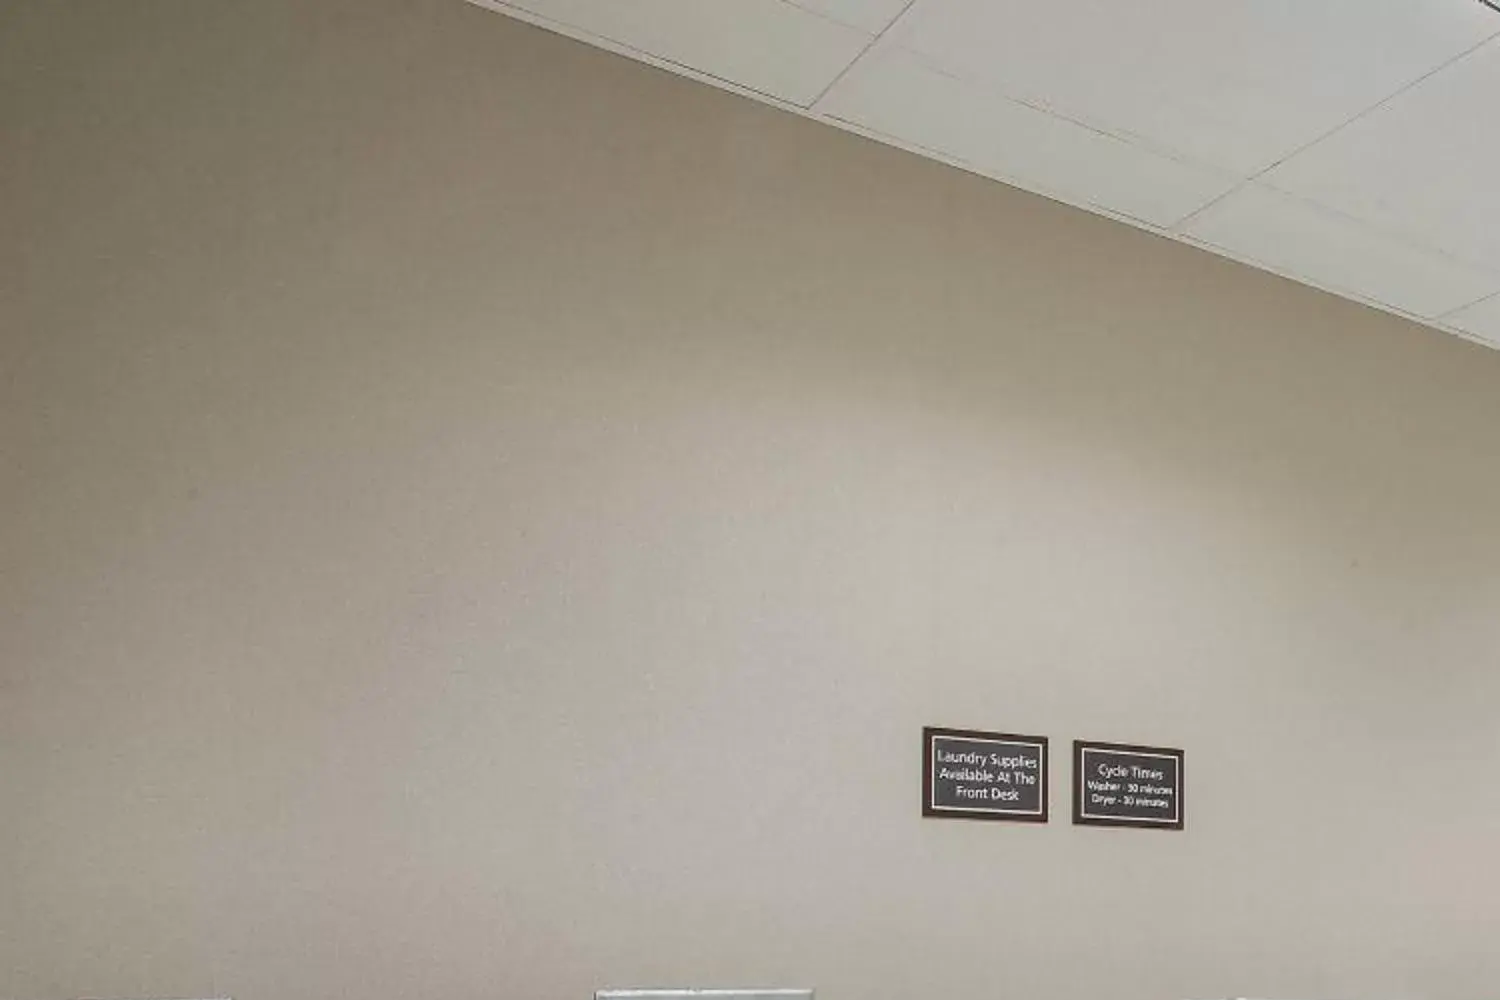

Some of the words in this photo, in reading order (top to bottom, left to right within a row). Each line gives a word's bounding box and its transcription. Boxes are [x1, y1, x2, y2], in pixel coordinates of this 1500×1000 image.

[937, 749, 986, 767] Laundry
[990, 753, 1037, 769] Supplies
[939, 767, 994, 783] Available
[997, 771, 1010, 783] At
[1014, 771, 1036, 785] The
[1098, 763, 1129, 778] Cycle
[1131, 766, 1164, 780] Times
[956, 785, 988, 799] Front
[991, 787, 1019, 801] Desk
[1087, 780, 1120, 791] Washer
[1140, 784, 1173, 795] minutes
[1091, 793, 1116, 806] Dryer
[1136, 798, 1169, 808] minutes
